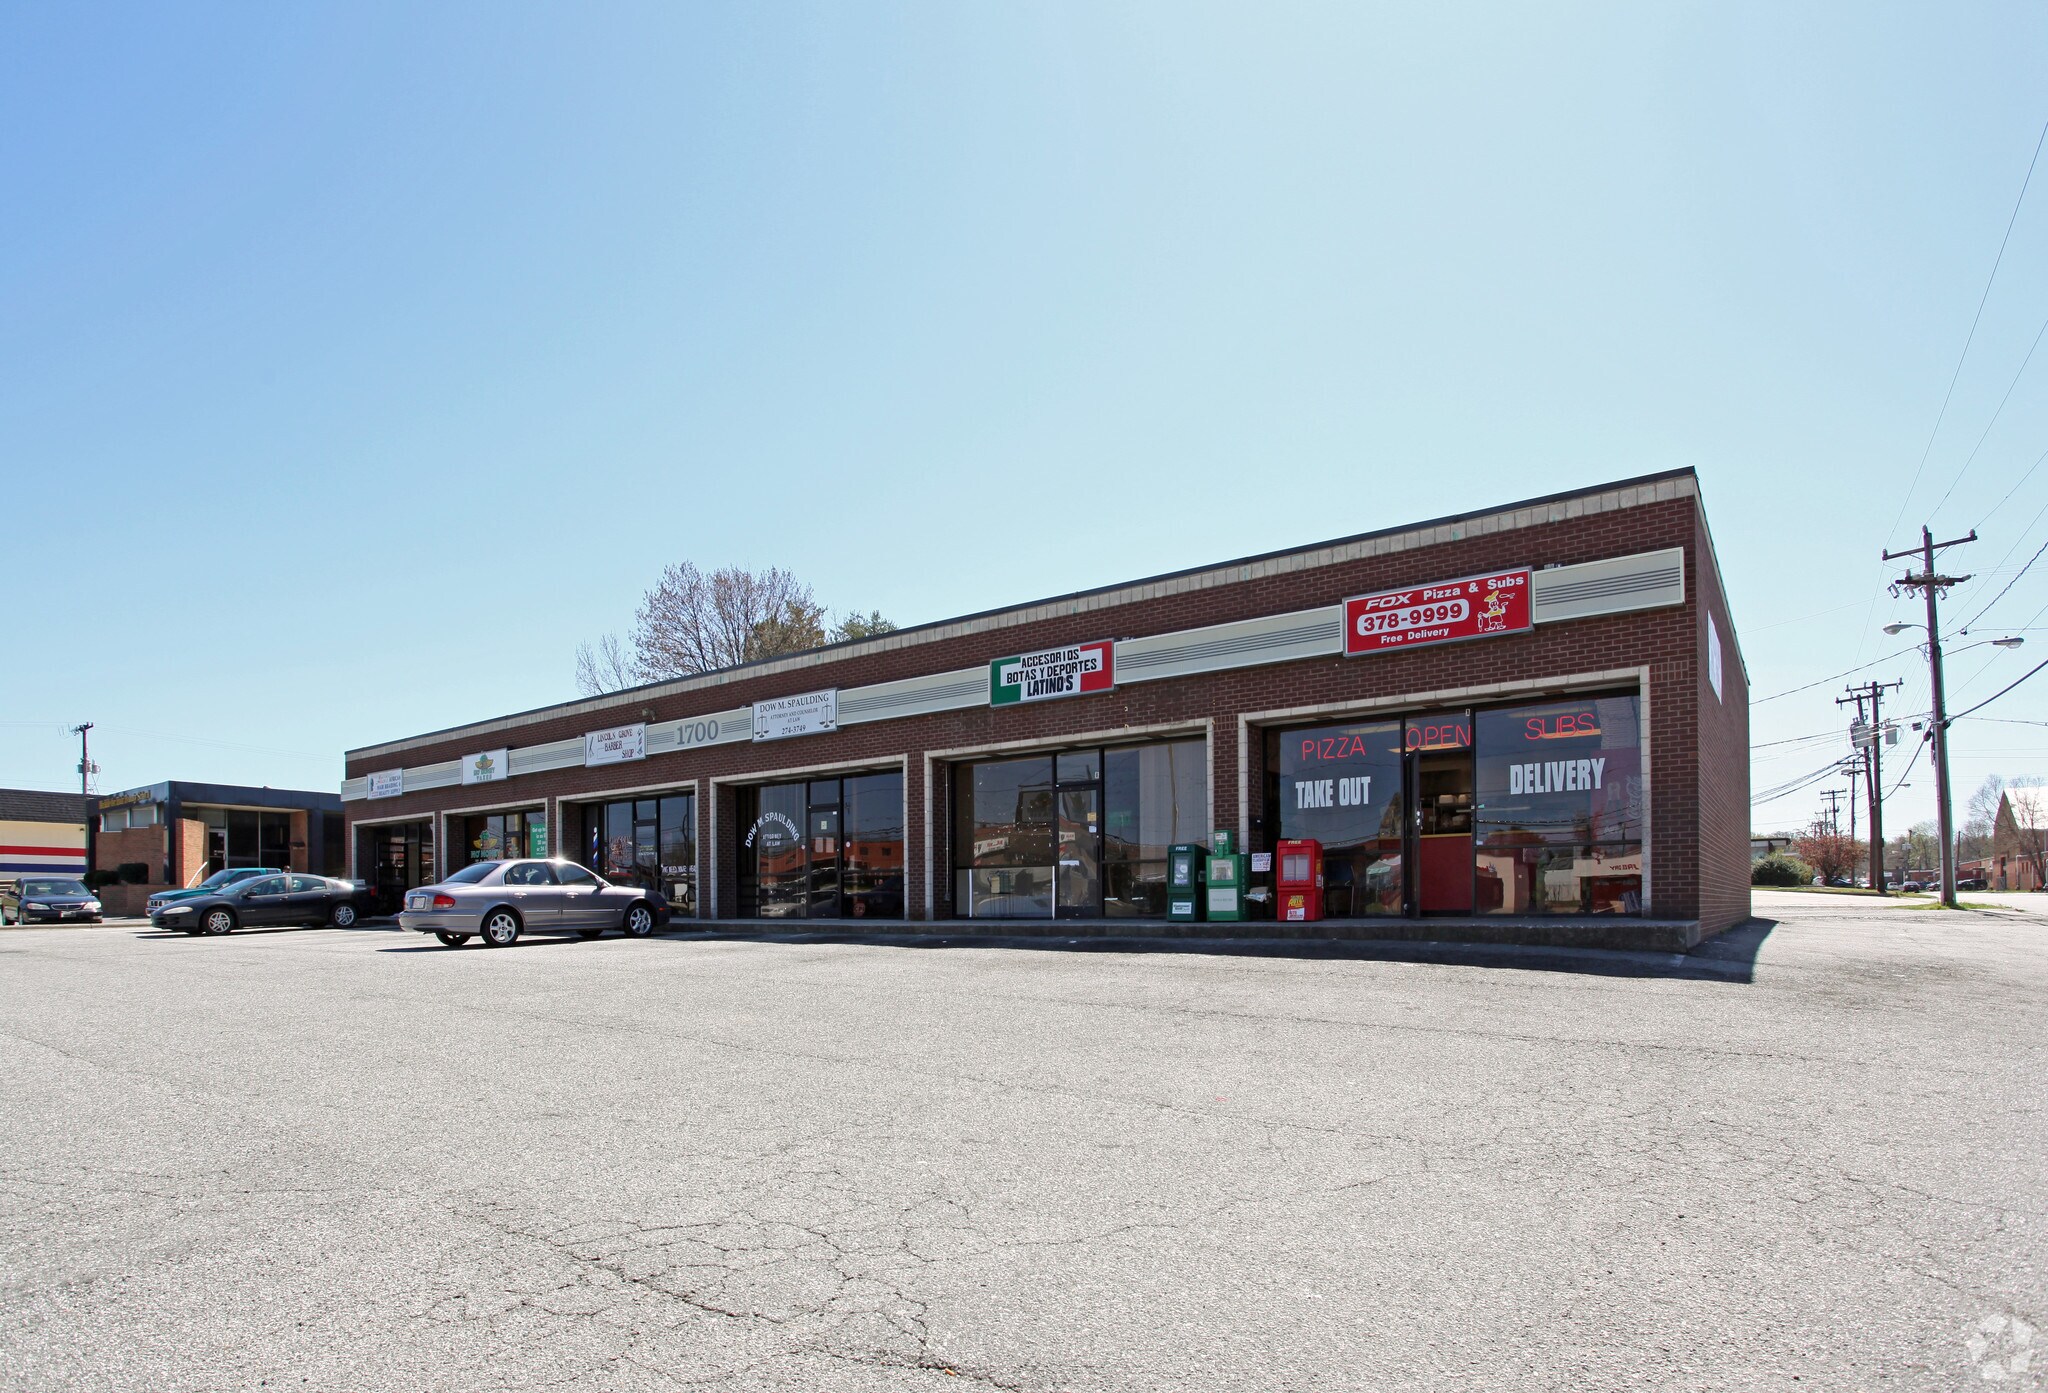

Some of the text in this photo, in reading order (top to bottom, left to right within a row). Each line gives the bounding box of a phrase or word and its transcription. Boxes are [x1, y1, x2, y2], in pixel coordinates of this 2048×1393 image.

[1365, 575, 1525, 611] FOX Pizza & Subs
[1363, 603, 1463, 632] 378-9999
[1381, 628, 1450, 644] Free Delivery
[1006, 658, 1097, 684] BOTAS Y DEPORTES
[1021, 649, 1080, 668] ACCESORIOS
[760, 693, 830, 713] DOW M. SPAULDING
[796, 708, 819, 716] COUNSELOR
[597, 729, 633, 743] LINCOLN GROVE
[676, 719, 719, 745] 1700
[781, 724, 807, 735] 274-3749
[1406, 724, 1471, 749] OPEN
[1524, 713, 1595, 740] SUBS
[604, 740, 623, 752] BARBER
[621, 749, 634, 758] SHOP
[1302, 736, 1366, 761] PIZZA
[1510, 757, 1606, 795] DELIVERY
[1295, 776, 1371, 809] TAKE OUT
[745, 823, 758, 848] DOW
[765, 812, 800, 842] SPAULDING
